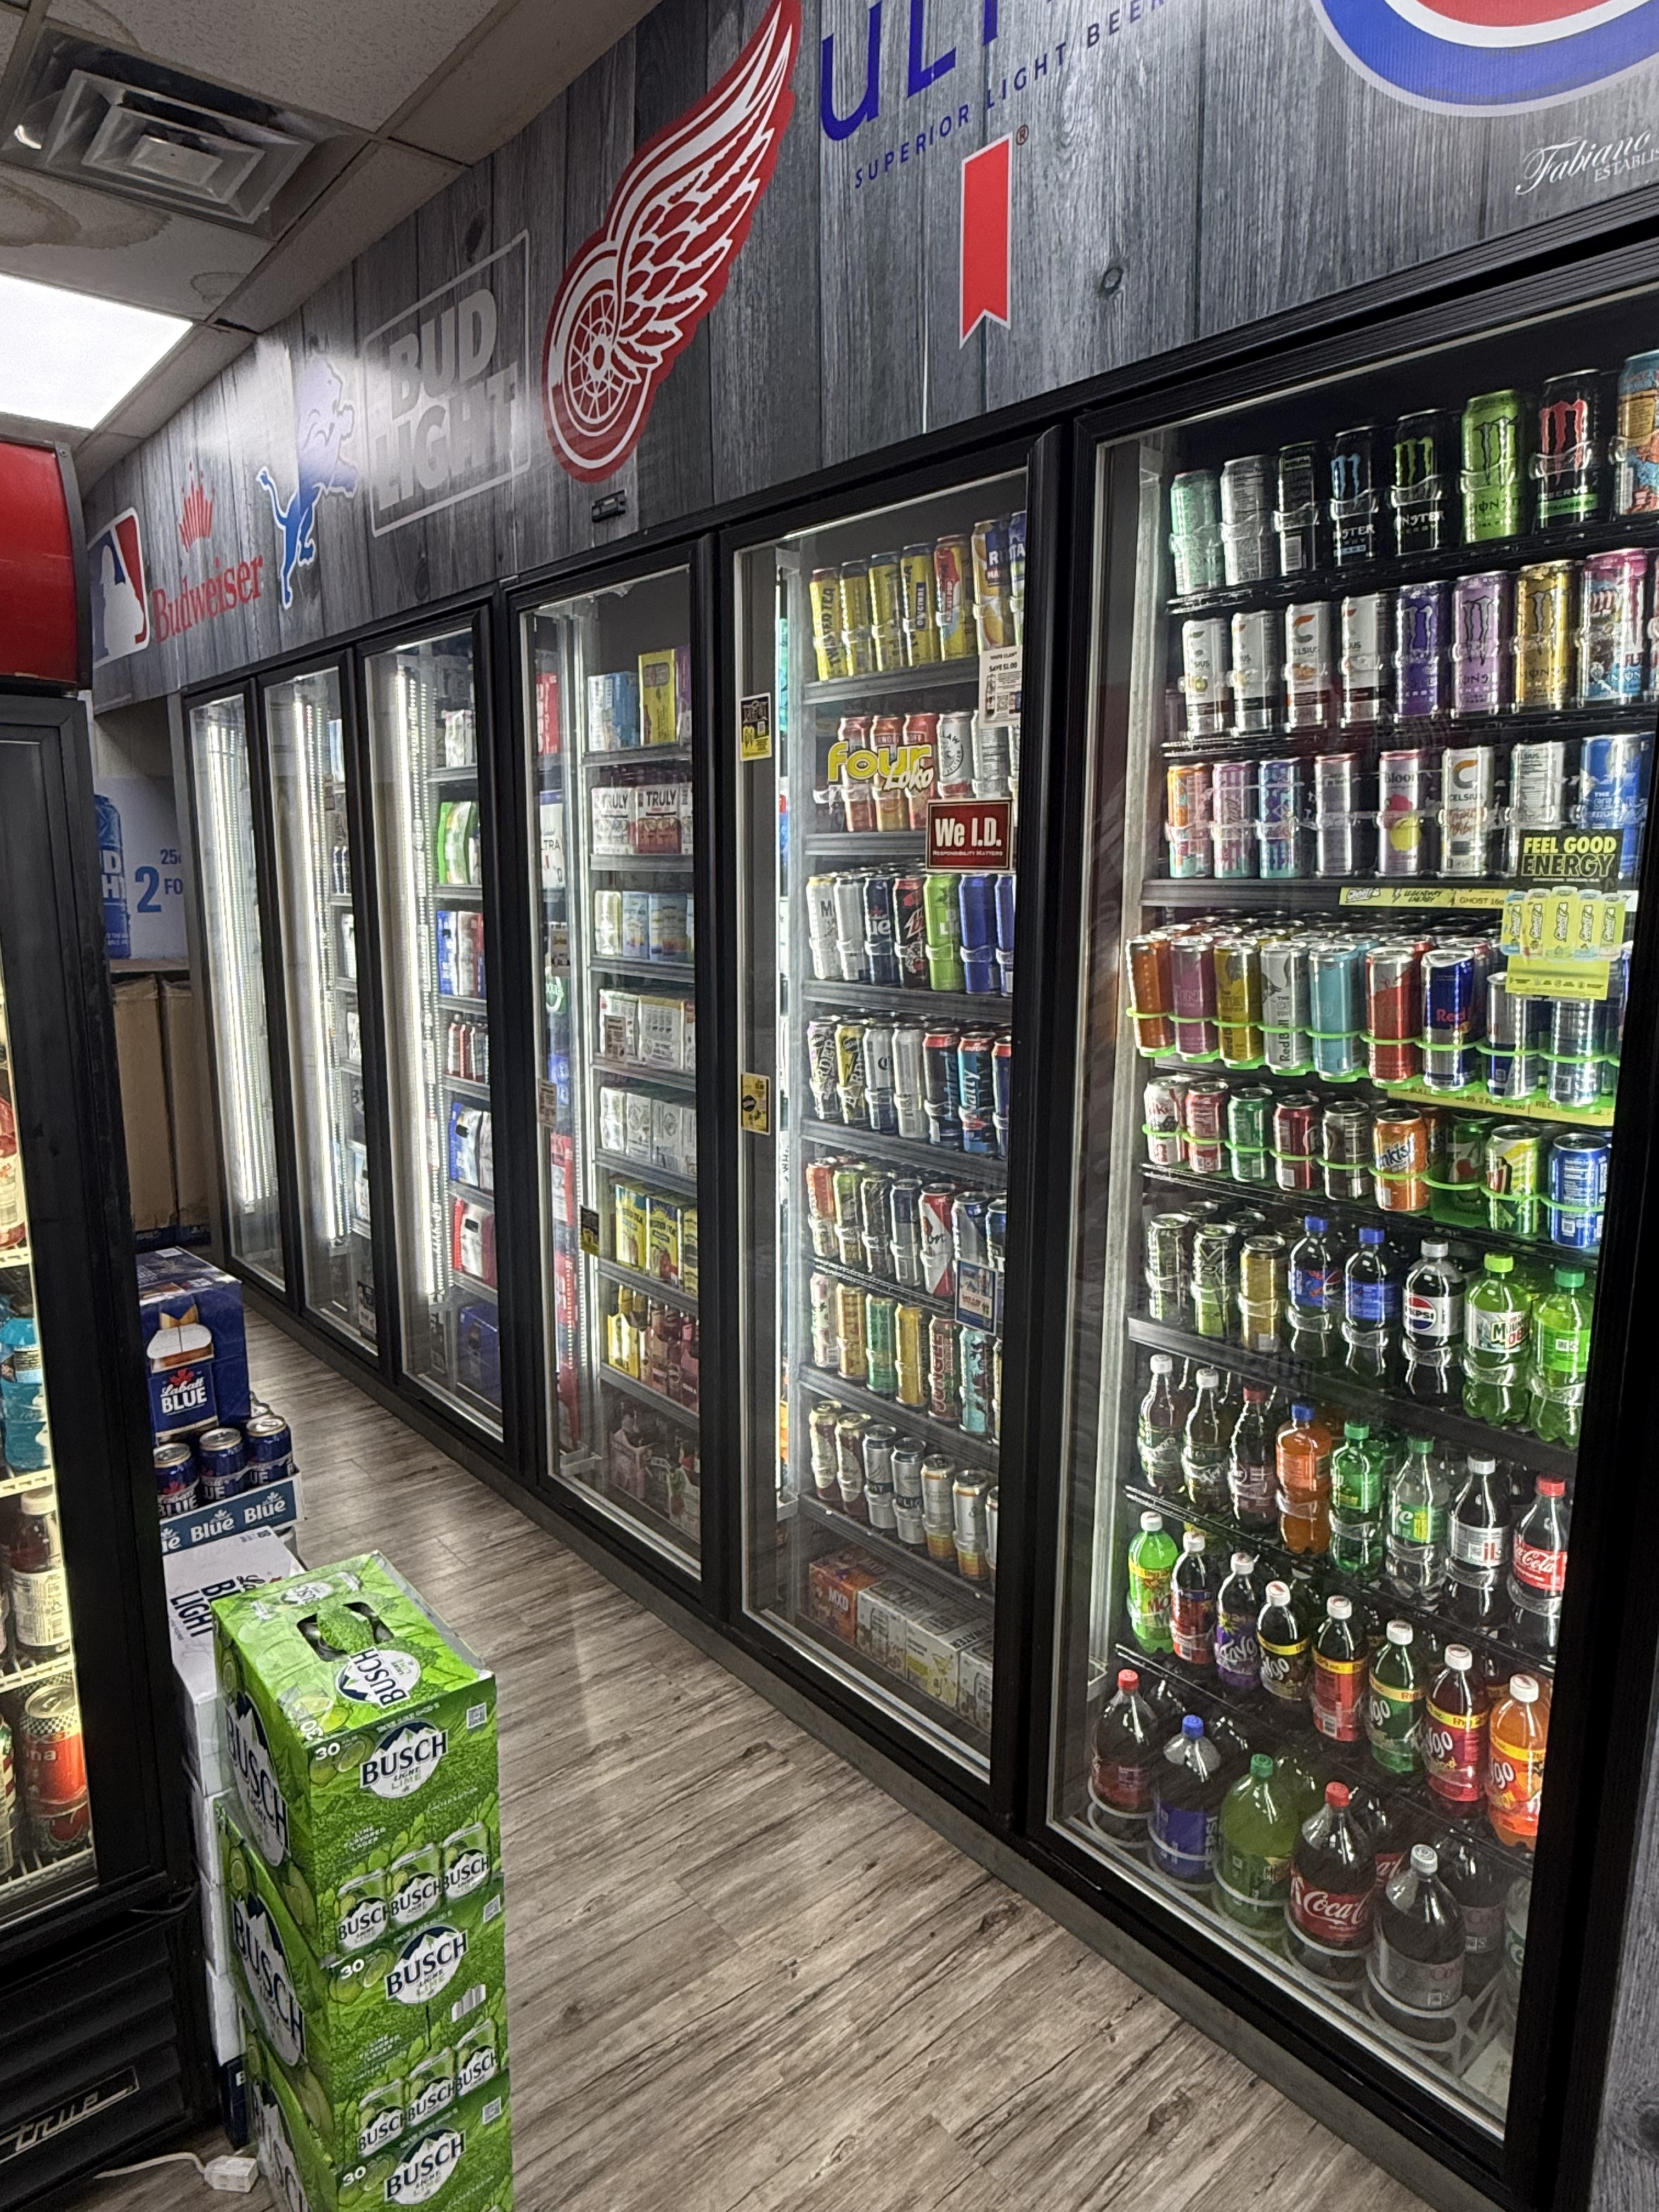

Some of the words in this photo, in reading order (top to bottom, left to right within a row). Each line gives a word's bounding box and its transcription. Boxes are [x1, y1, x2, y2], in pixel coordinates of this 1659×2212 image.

[855, 104, 970, 189] SUPERIOR
[987, 42, 1067, 109] LIGHT
[1086, 0, 1165, 48] BEE
[1515, 130, 1651, 195] Fabiano
[387, 287, 498, 420] BUD
[375, 361, 517, 511] LIGHT
[152, 555, 264, 643] Budweiser
[823, 588, 836, 609] TEA
[827, 740, 932, 783] four
[884, 761, 934, 792] Loko
[646, 789, 676, 806] TRULY
[541, 839, 561, 850] LTRA
[934, 817, 966, 848] We
[970, 817, 1002, 848] I.D.
[1523, 837, 1559, 854] FEEL
[1564, 836, 1617, 854] GOOD
[1521, 854, 1616, 877] ENERGY
[135, 866, 162, 913] 2
[165, 878, 183, 895] FO
[1459, 897, 1488, 905] GHOST
[1436, 1008, 1466, 1023] Red
[1376, 1135, 1415, 1167] nkist
[161, 1376, 205, 1398] Labatt
[162, 1386, 207, 1414] BLUE
[245, 1498, 286, 1524] Blue
[191, 1516, 235, 1543] Blue
[827, 1586, 849, 1612] MXD
[349, 1646, 409, 1708] BUSCH
[300, 1719, 325, 1741] 30
[314, 1742, 341, 1762] 30
[362, 1731, 447, 1786] BUSCH
[226, 1706, 290, 1850] BUSCH
[443, 1854, 490, 1891] BUSCH
[391, 1880, 442, 1917] BUSCH
[338, 1904, 390, 1941] BUSCH
[234, 1902, 304, 2054] BUSCH
[340, 1959, 365, 1980] 30
[386, 1933, 467, 1997] BUSCH
[455, 2052, 496, 2092] BUSCH
[408, 2083, 456, 2122] BUSCH
[359, 2114, 408, 2152] BUSCH
[342, 2166, 367, 2187] 30
[387, 2132, 465, 2198] BUSCH
